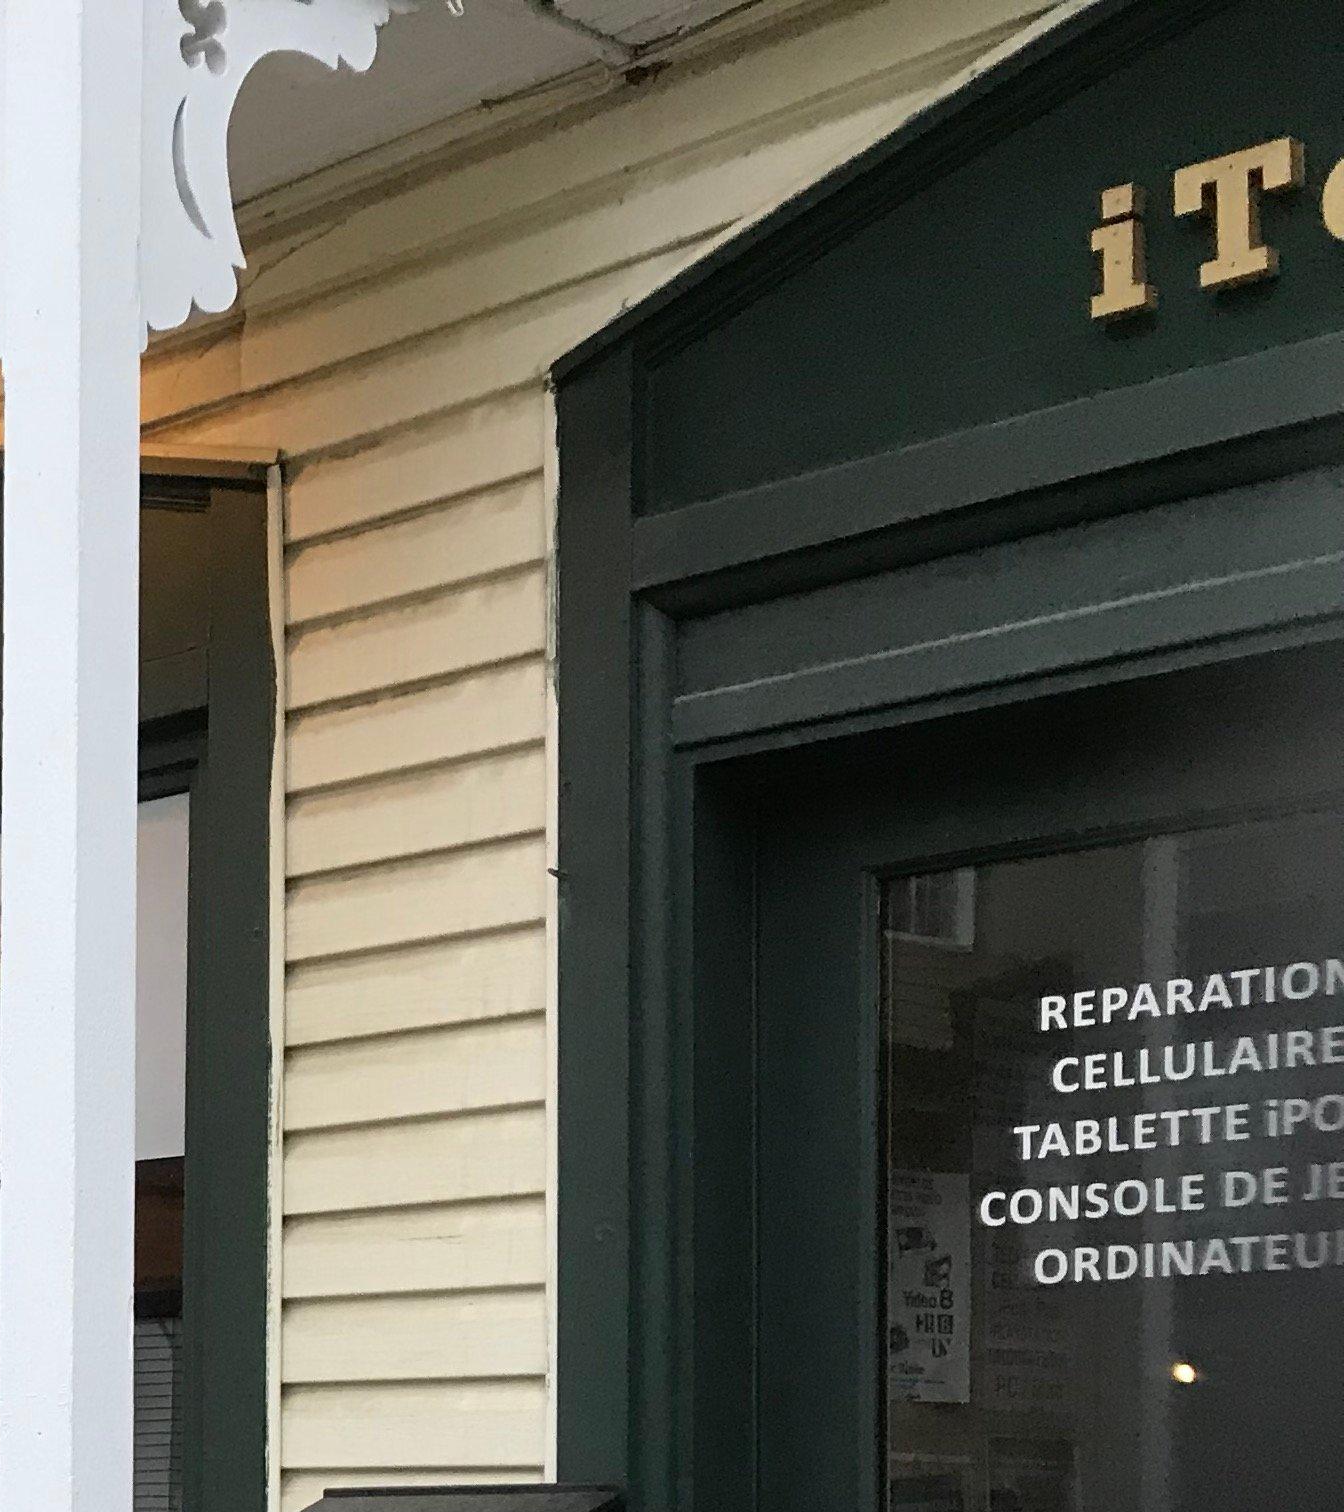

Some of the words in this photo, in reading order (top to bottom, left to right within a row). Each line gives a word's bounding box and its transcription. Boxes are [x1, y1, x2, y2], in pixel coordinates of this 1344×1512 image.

[1091, 136, 1344, 320] iT
[1052, 1025, 1344, 1093] CELLULAIRE
[1013, 1103, 1250, 1161] TABLETTE
[979, 1173, 1205, 1227] CONSOLE
[1224, 1167, 1288, 1208] DE
[1033, 1228, 1344, 1284] ORDINATEU
